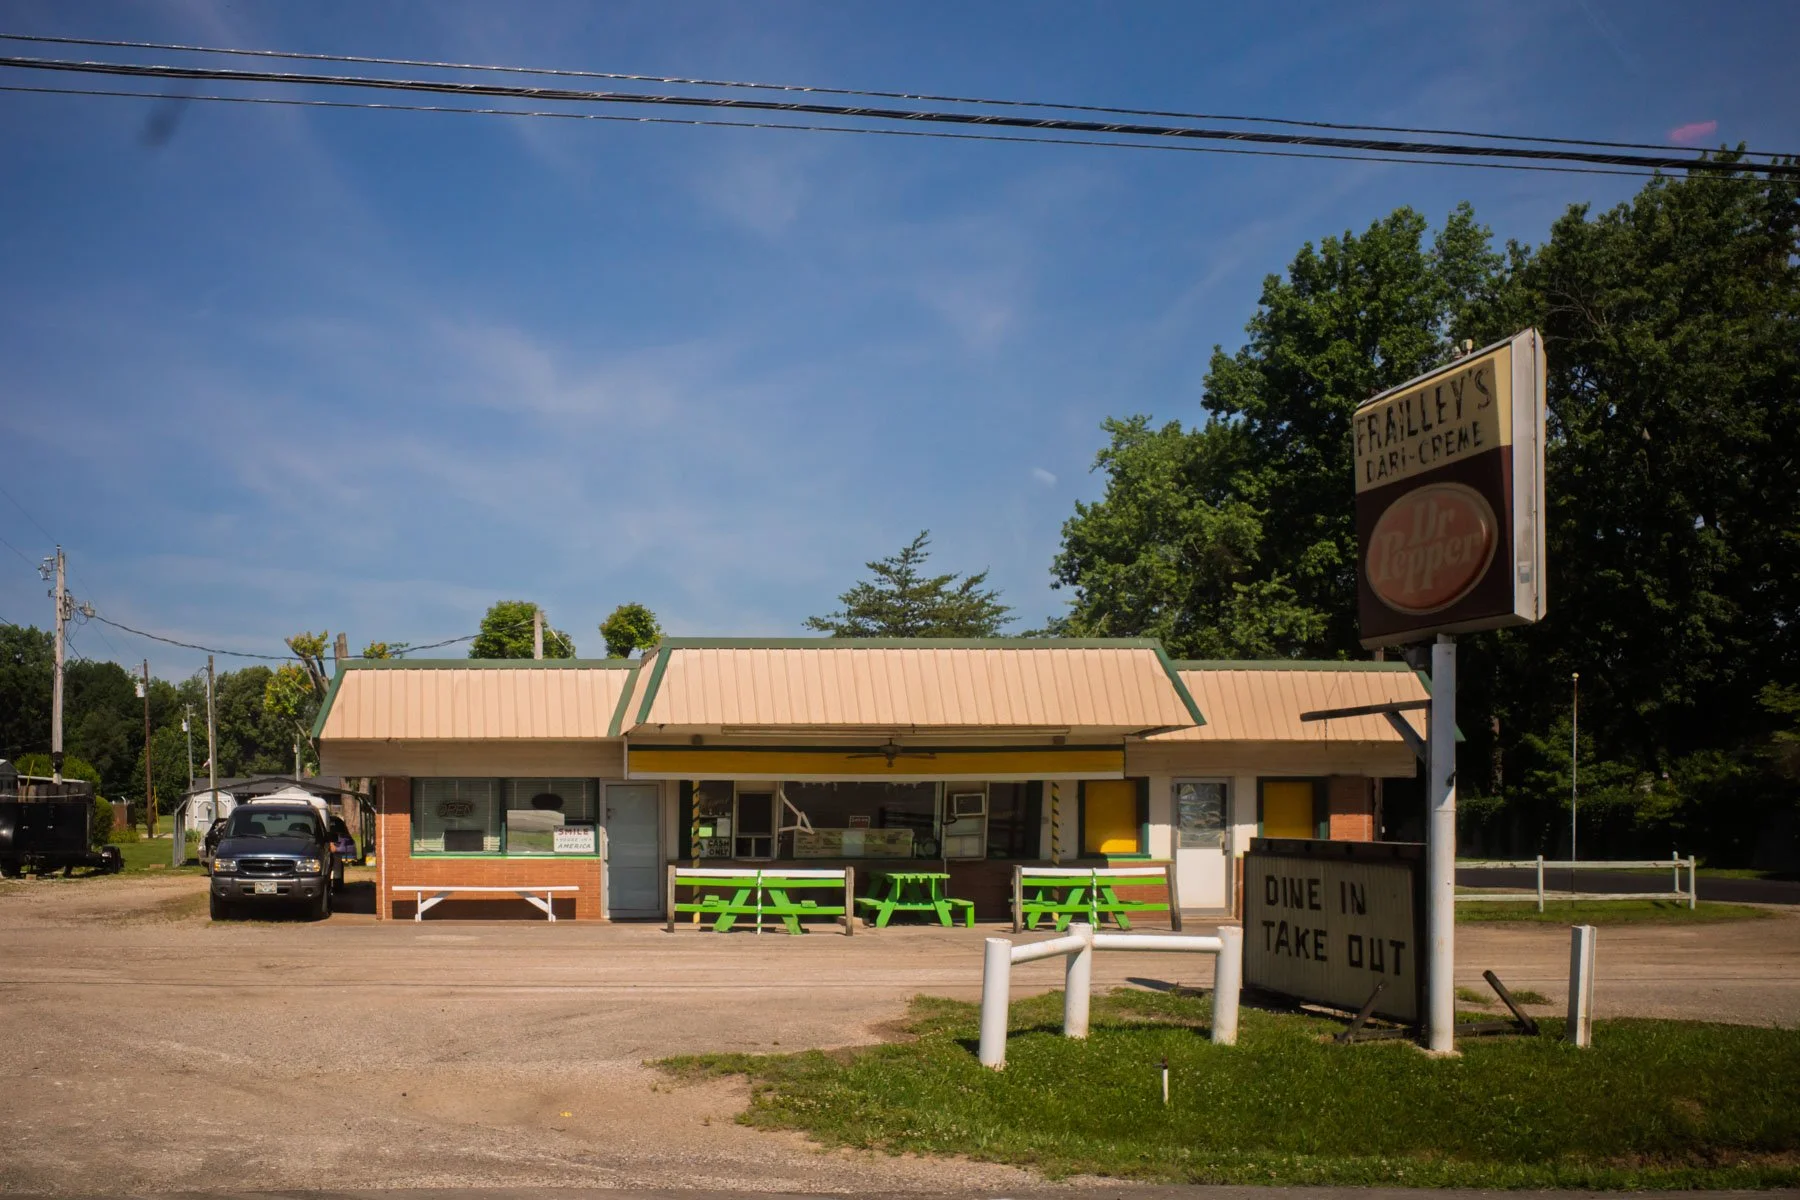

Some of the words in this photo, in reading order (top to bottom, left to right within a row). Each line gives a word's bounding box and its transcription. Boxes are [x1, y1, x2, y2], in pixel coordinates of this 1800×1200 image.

[1355, 368, 1492, 457] FRAILLEY'S
[1366, 421, 1483, 483] DARI-CREME
[1412, 500, 1455, 546] Dr
[1378, 531, 1482, 595] Pepper
[558, 828, 589, 836] SMILE
[708, 839, 729, 847] CASH
[709, 848, 729, 856] ONLY
[1265, 875, 1321, 910] DINE
[1340, 881, 1367, 915] IN
[1262, 920, 1328, 961] TAKE
[1348, 934, 1406, 976] OUT
